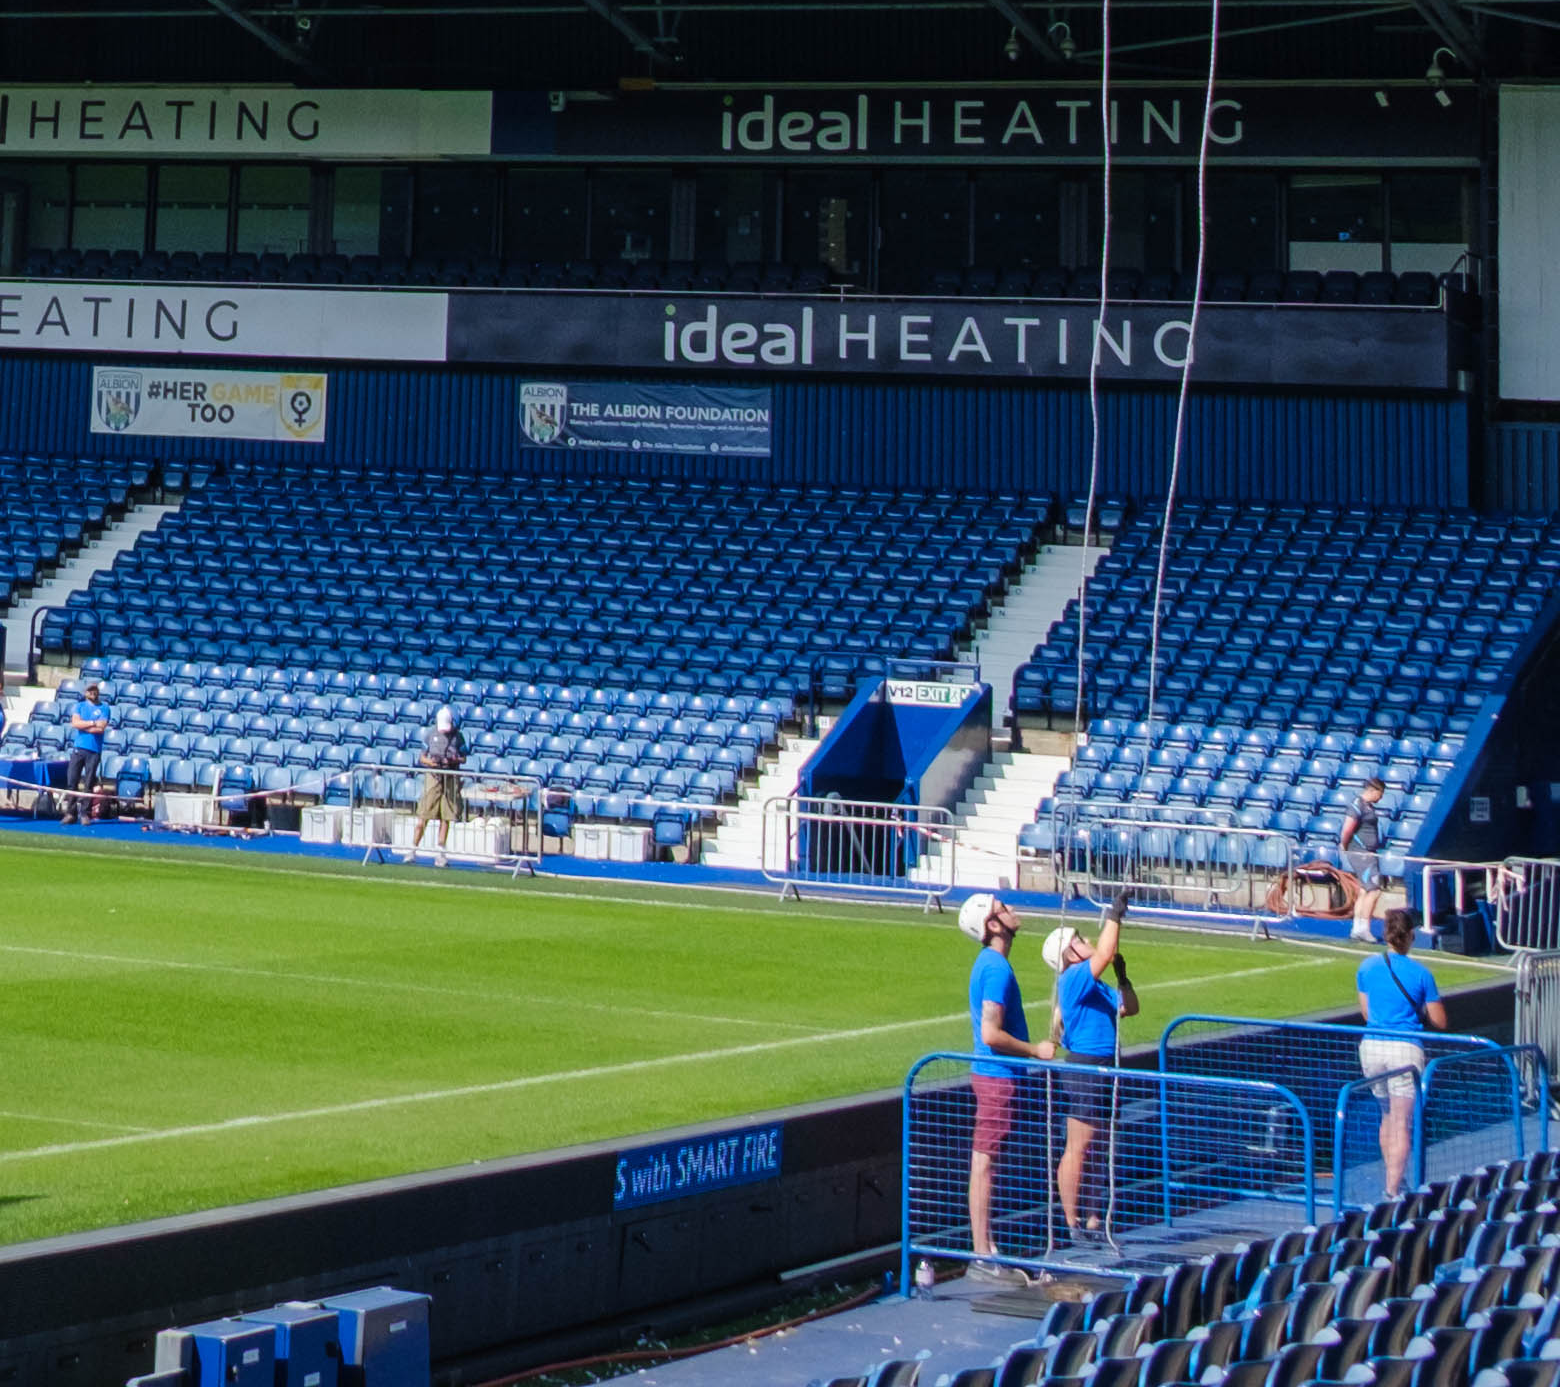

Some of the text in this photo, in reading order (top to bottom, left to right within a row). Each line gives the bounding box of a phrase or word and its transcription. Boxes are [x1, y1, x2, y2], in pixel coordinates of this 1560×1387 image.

[29, 99, 320, 141] HEATING
[721, 94, 1244, 150] ideal HEATING
[664, 304, 1195, 367] ideal HEATING
[98, 378, 139, 390] ALBION
[147, 381, 276, 404] #HER GAME
[523, 387, 564, 398] ALBION
[187, 403, 235, 423] TOO
[571, 403, 769, 423] THE ALBION FOUNDATION
[889, 686, 948, 702] V12 EXIT
[614, 1129, 778, 1201] S with SMART FIRE
